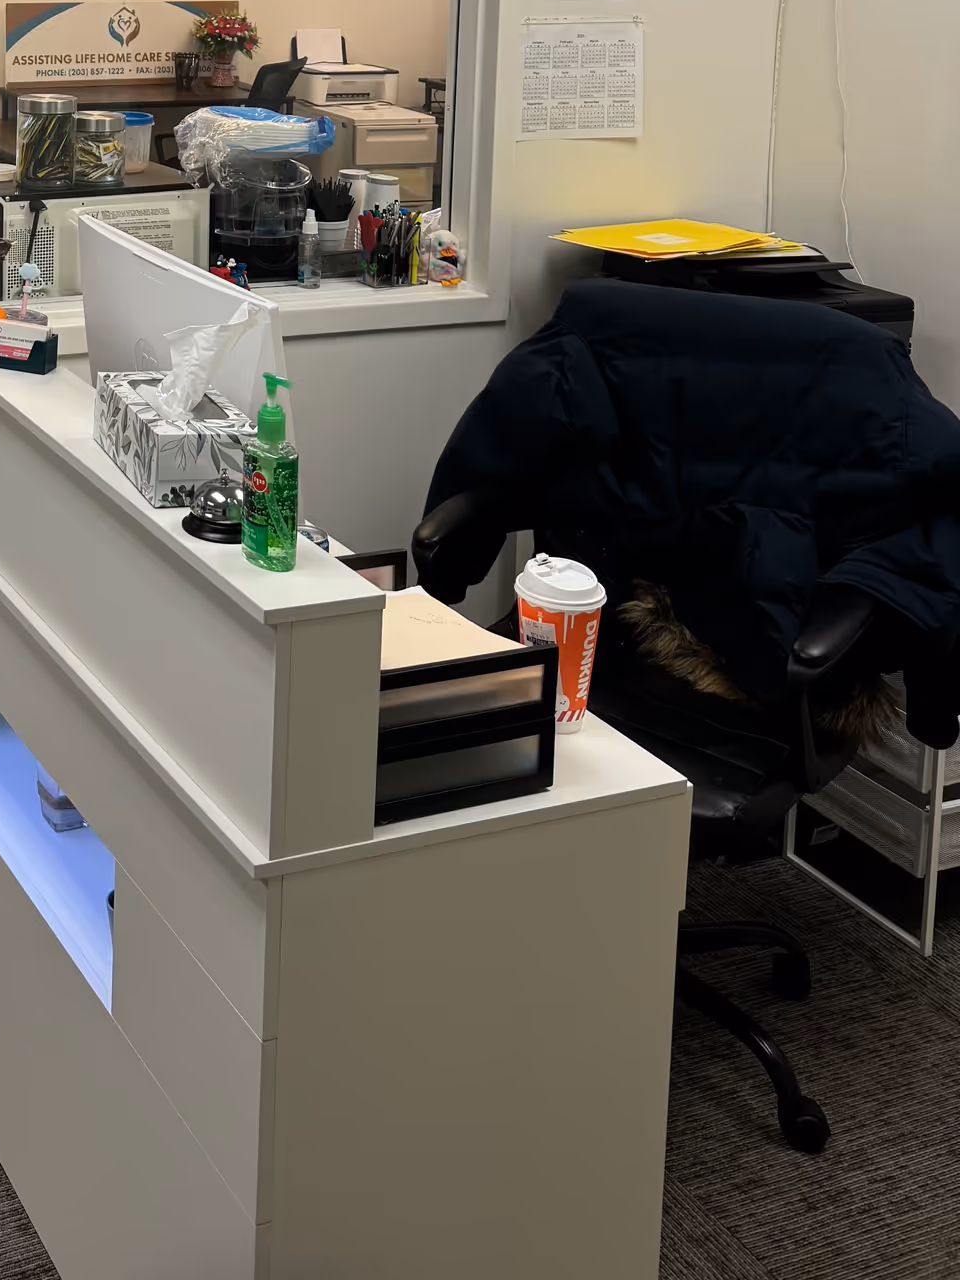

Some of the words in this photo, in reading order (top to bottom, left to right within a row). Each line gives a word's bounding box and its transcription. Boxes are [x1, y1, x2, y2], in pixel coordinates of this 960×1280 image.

[12, 54, 72, 66] ASSISTING
[75, 53, 96, 64] LIFE
[97, 52, 132, 63] HOME
[134, 52, 162, 62] CARE
[36, 68, 67, 77] PHONE:
[68, 68, 89, 77] (203)
[90, 67, 125, 76] 857-1222
[136, 66, 153, 74] FAX:
[154, 65, 174, 75] (203)
[575, 619, 598, 702] DUNKIN'
